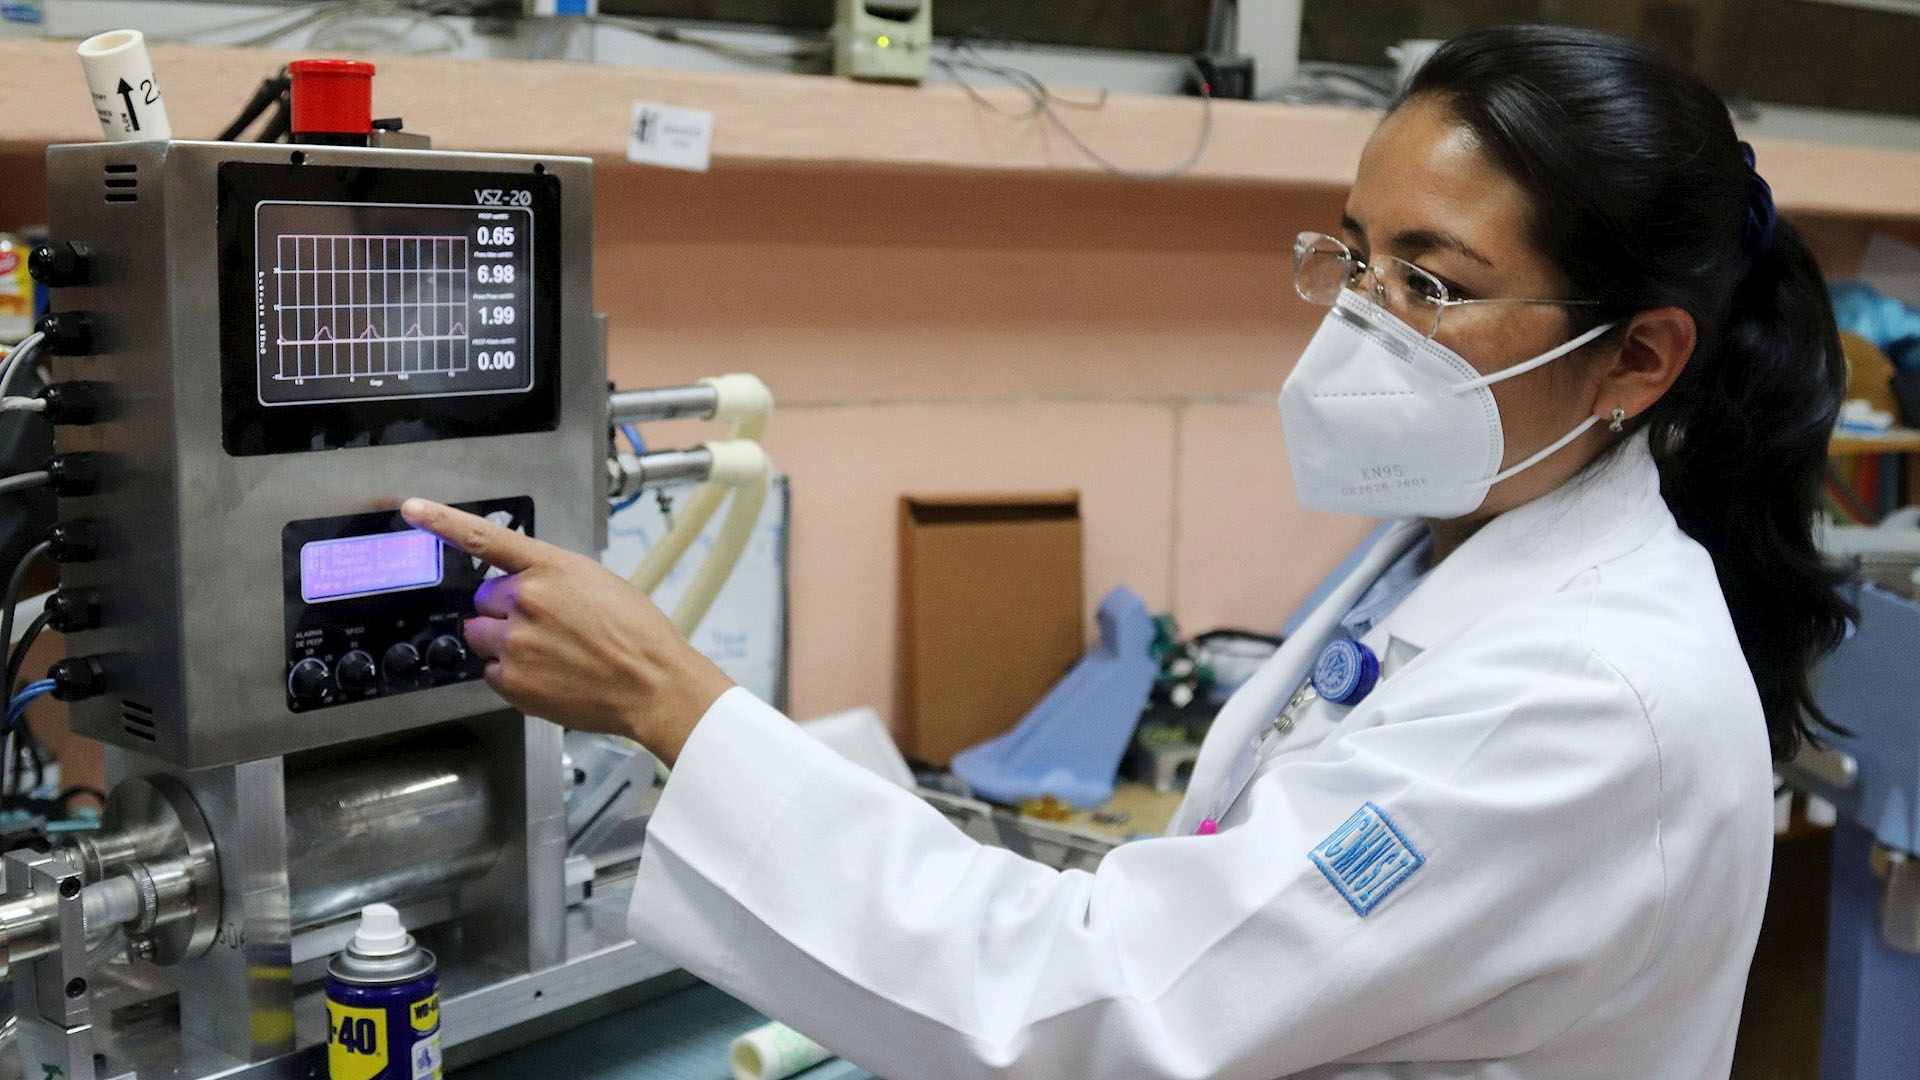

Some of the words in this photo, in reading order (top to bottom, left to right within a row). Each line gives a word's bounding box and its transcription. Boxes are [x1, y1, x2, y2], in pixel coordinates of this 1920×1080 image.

[474, 189, 532, 206] VSZ-20
[477, 226, 515, 246] 0.65
[477, 264, 515, 284] 6.98
[478, 306, 515, 325] 1.99
[477, 351, 515, 371] 0.00
[1361, 465, 1404, 480] KN95
[295, 630, 323, 638] ALARMA
[306, 638, 322, 646] PEEP
